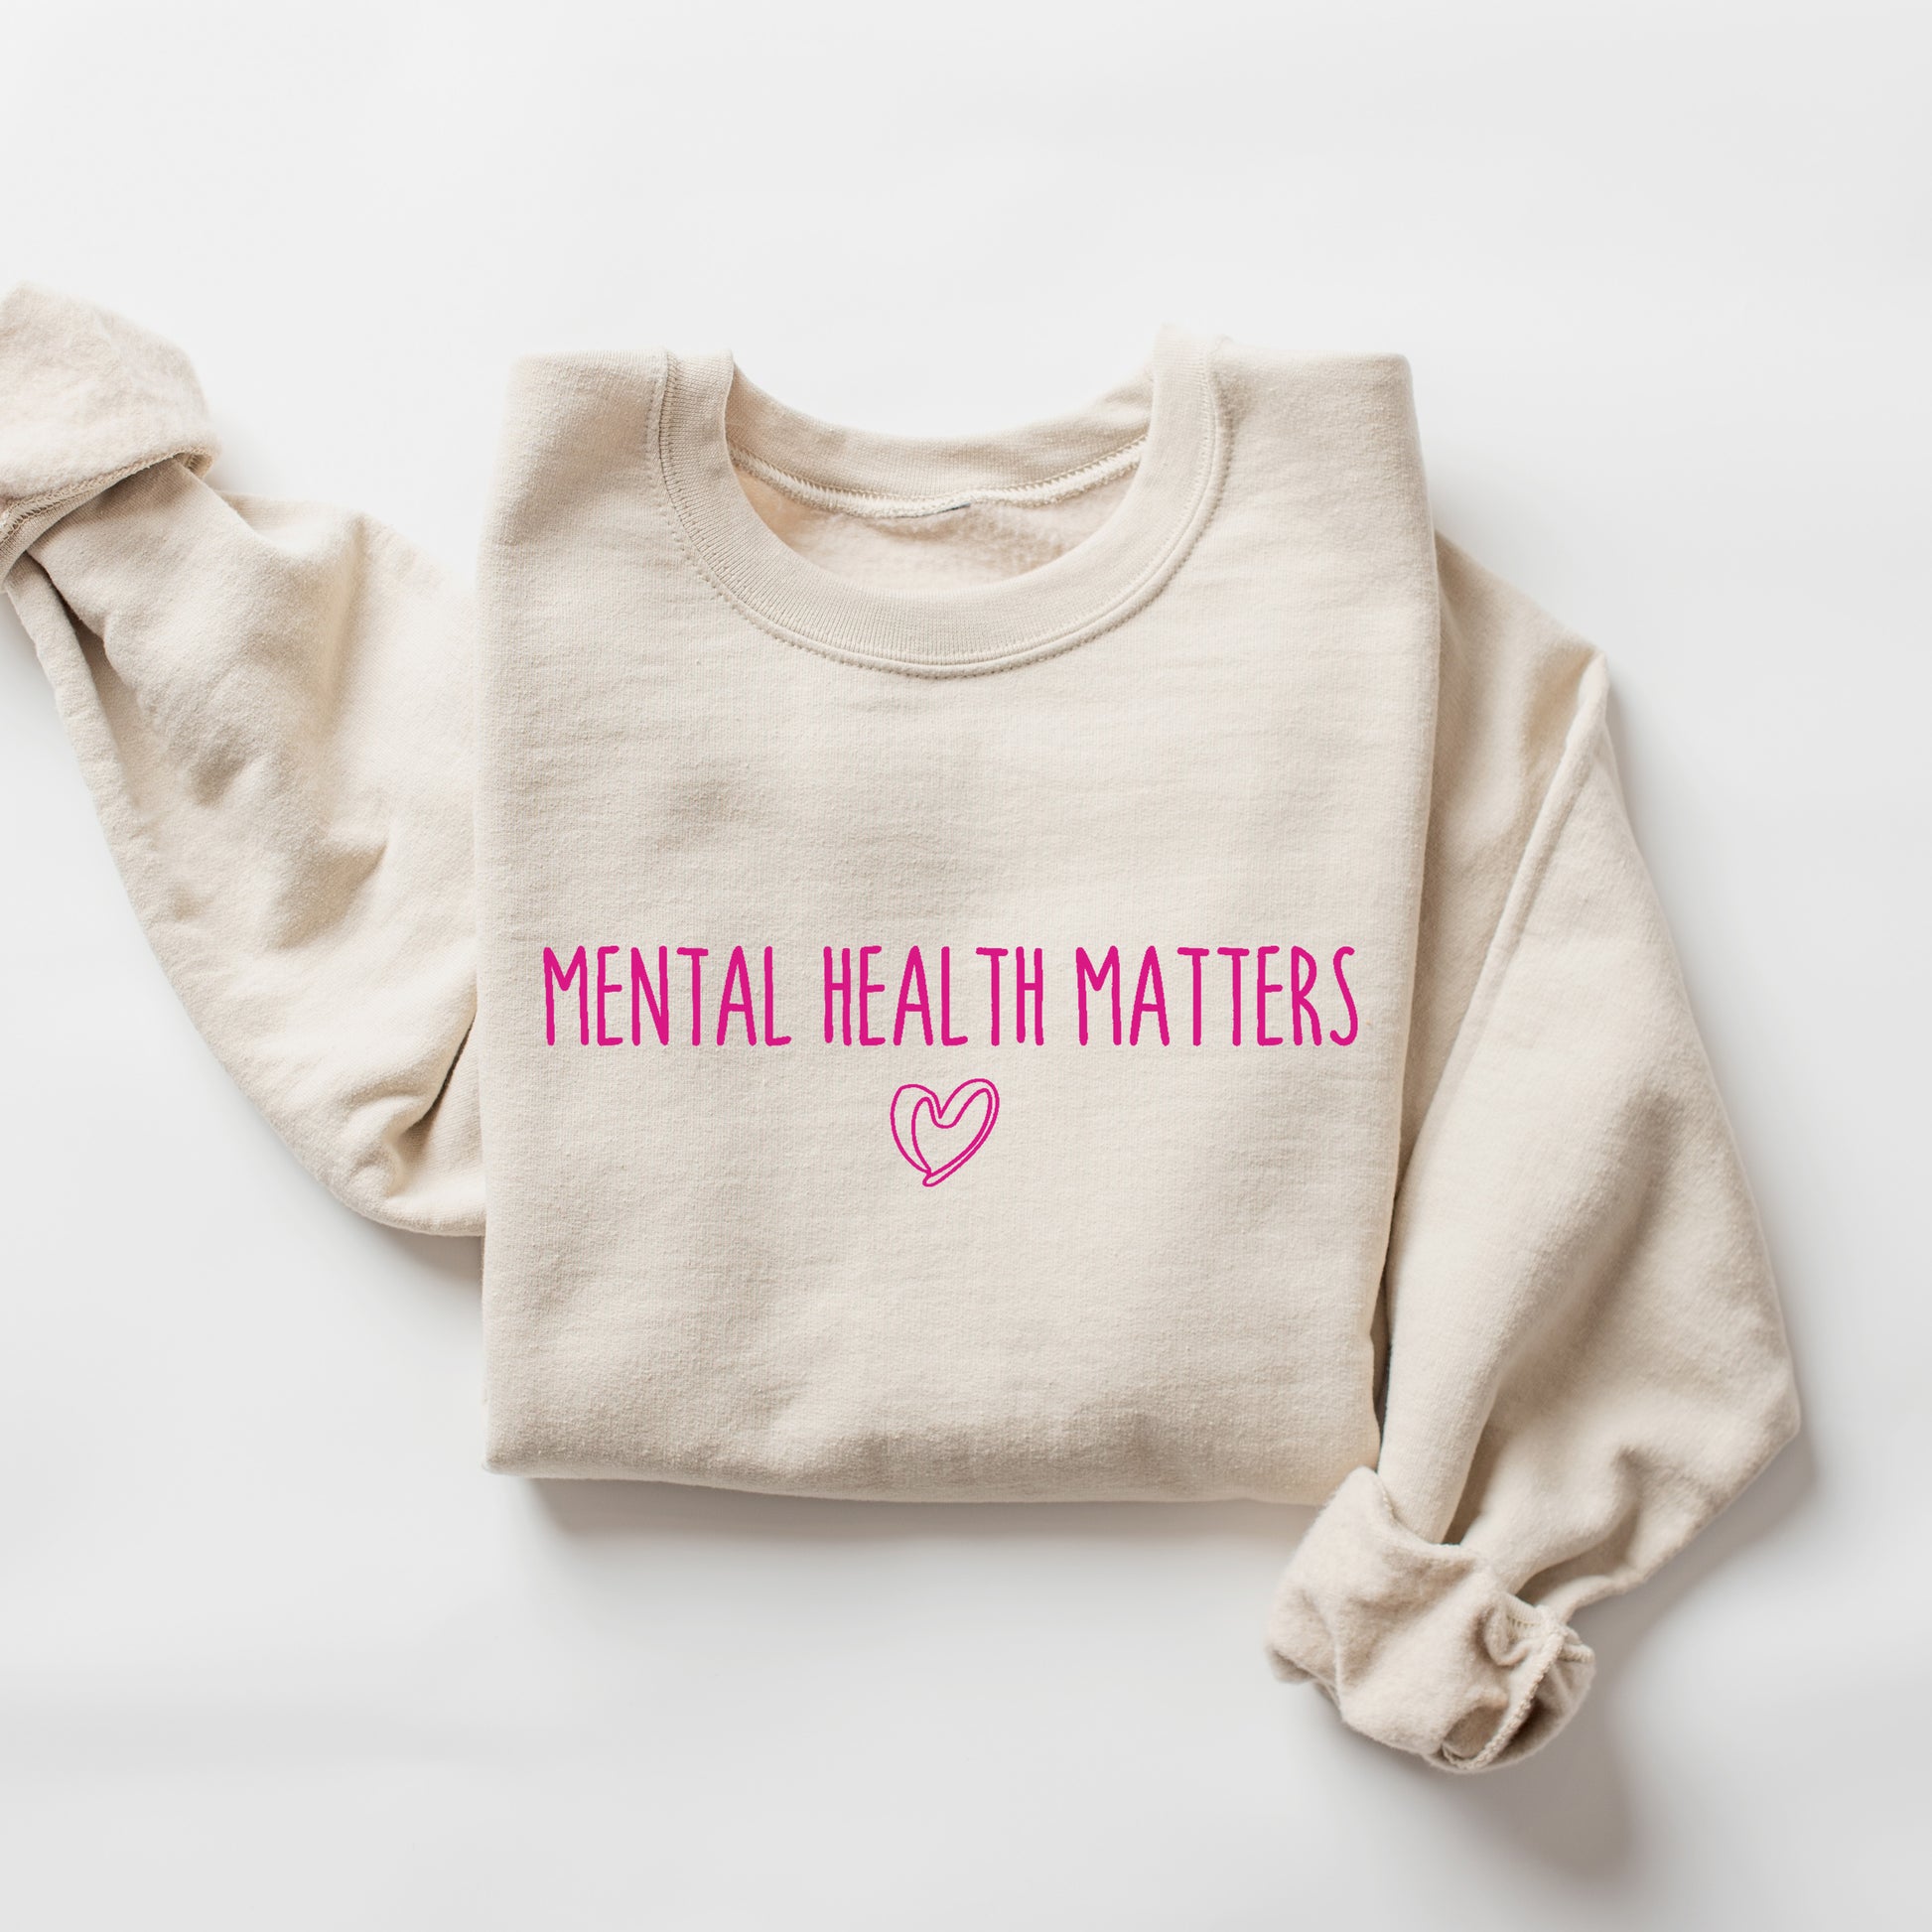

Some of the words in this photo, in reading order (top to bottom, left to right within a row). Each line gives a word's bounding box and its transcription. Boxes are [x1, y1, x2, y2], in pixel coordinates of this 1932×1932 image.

[542, 944, 792, 1047] MENTAL
[822, 944, 1045, 1047] HEALTH
[1074, 944, 1359, 1047] MATTERS
